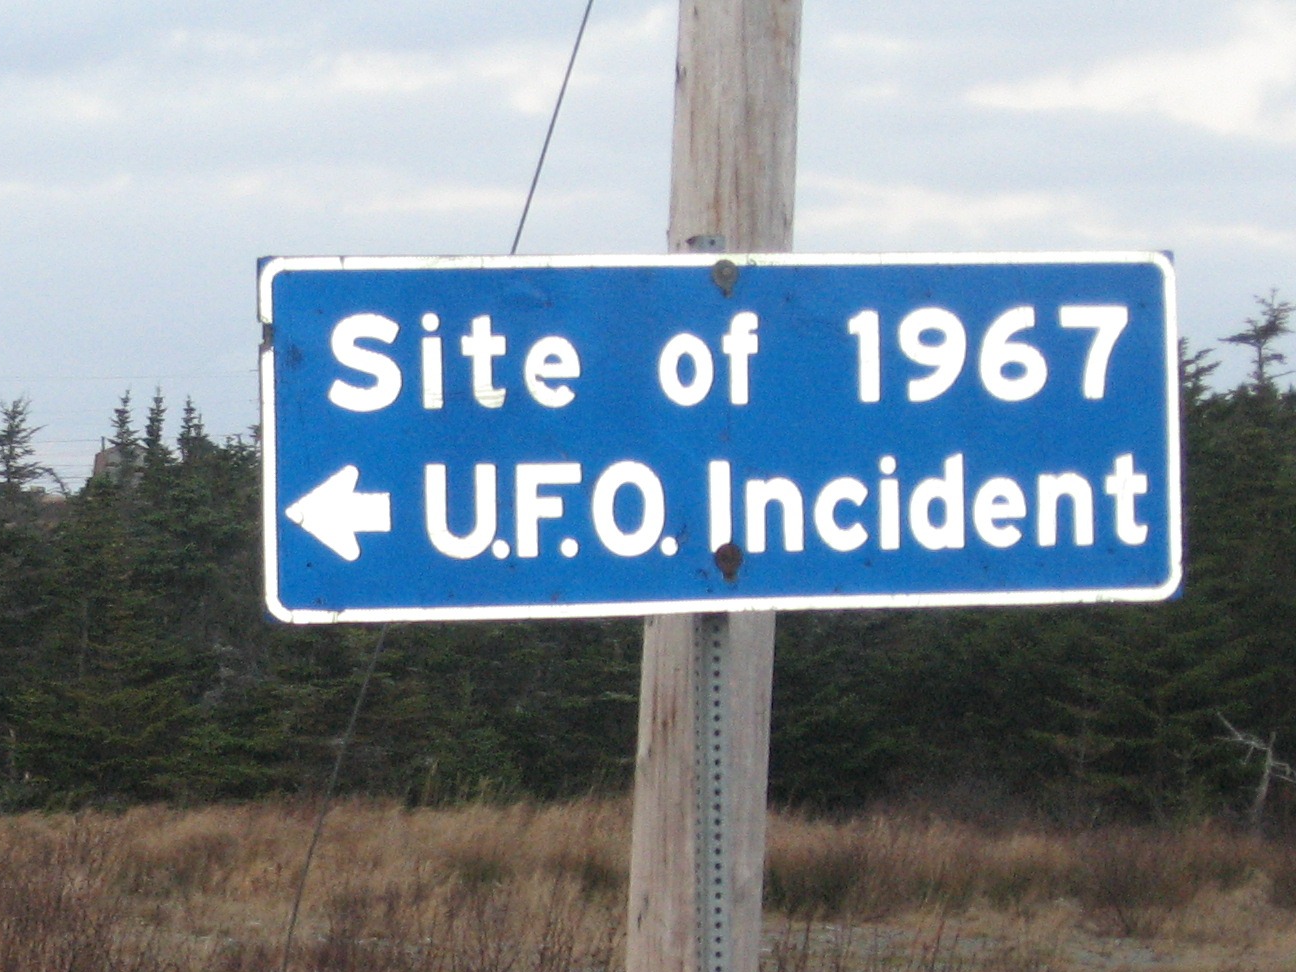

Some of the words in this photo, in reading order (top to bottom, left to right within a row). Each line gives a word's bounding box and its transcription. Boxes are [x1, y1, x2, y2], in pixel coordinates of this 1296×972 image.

[327, 311, 581, 413] Site
[657, 310, 759, 407] of
[846, 302, 1129, 404] 1967
[423, 459, 679, 560] U.F.O.
[707, 452, 1149, 554] Incident
